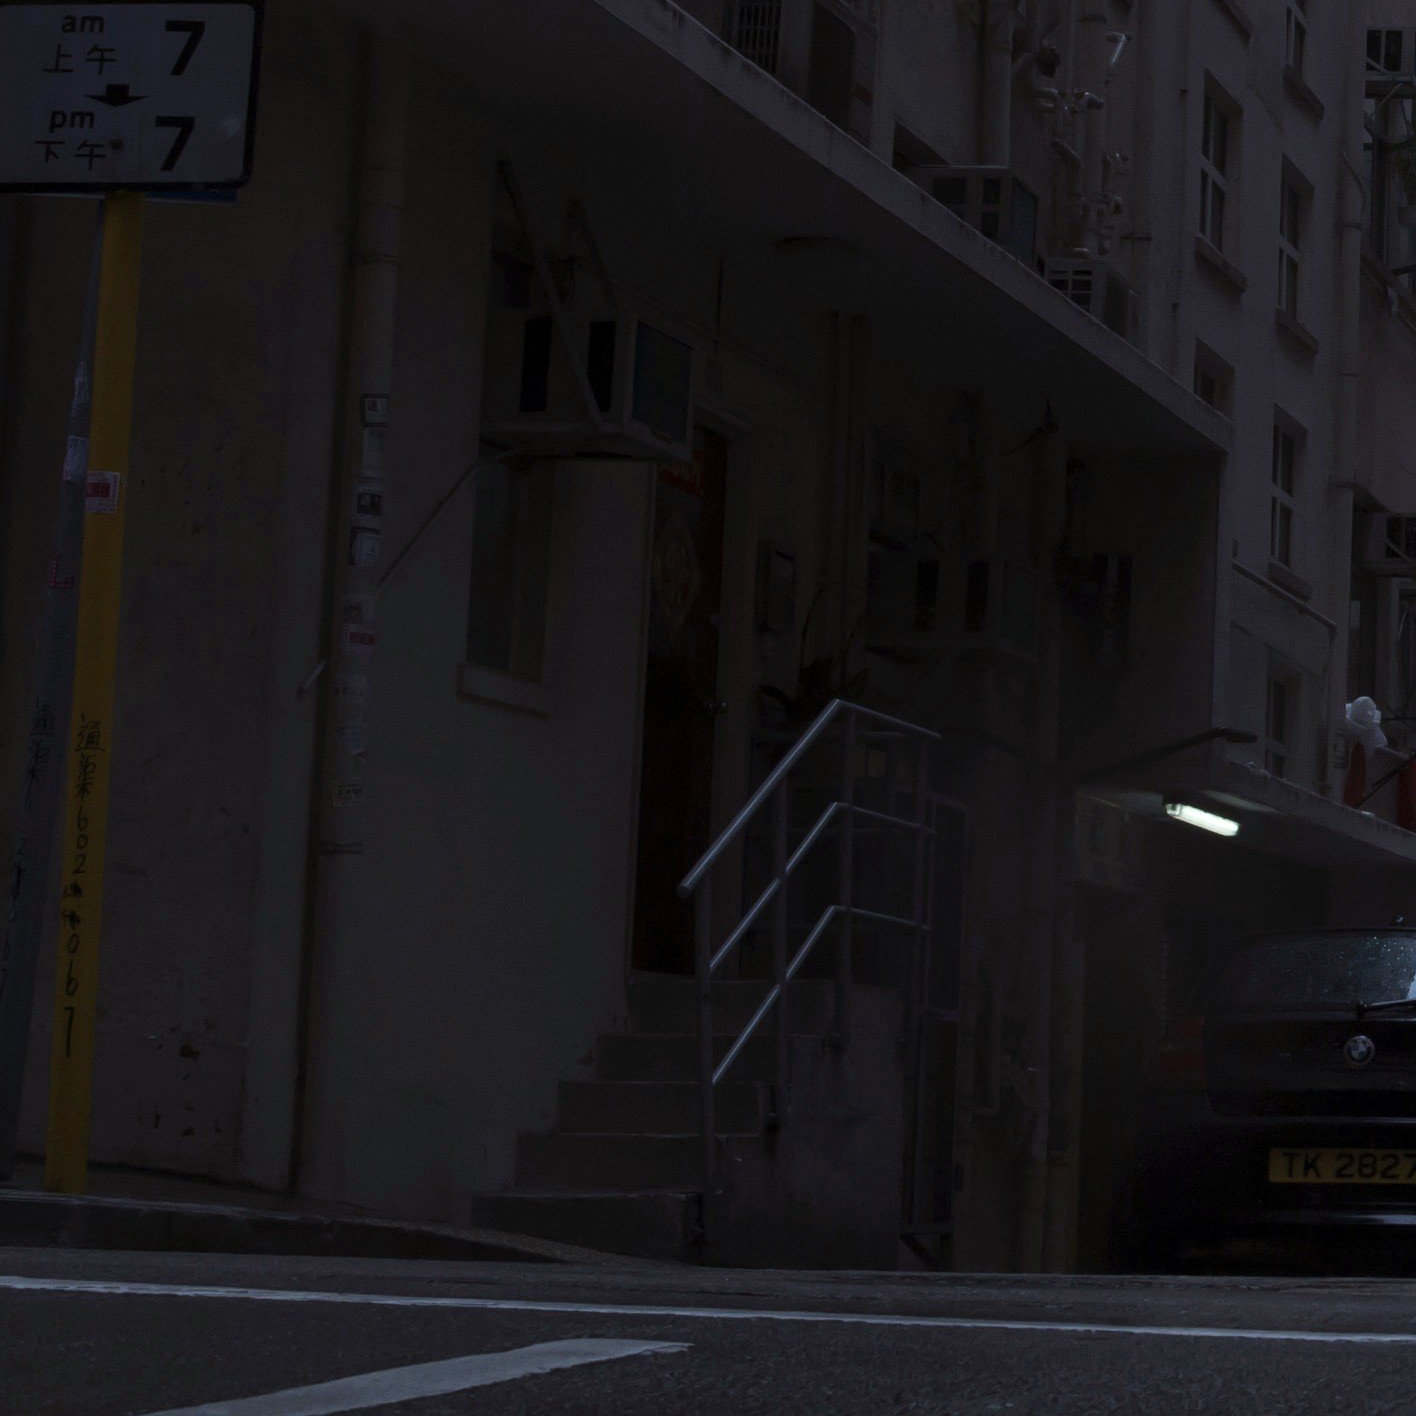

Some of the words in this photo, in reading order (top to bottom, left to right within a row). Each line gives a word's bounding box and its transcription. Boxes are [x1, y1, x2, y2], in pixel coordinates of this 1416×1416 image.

[61, 15, 105, 34] am
[44, 43, 117, 76] 上午
[164, 20, 206, 76] 7
[49, 110, 94, 133] pm
[34, 139, 107, 171] 下午
[155, 115, 196, 172] 7
[1282, 1152, 1322, 1178] TK
